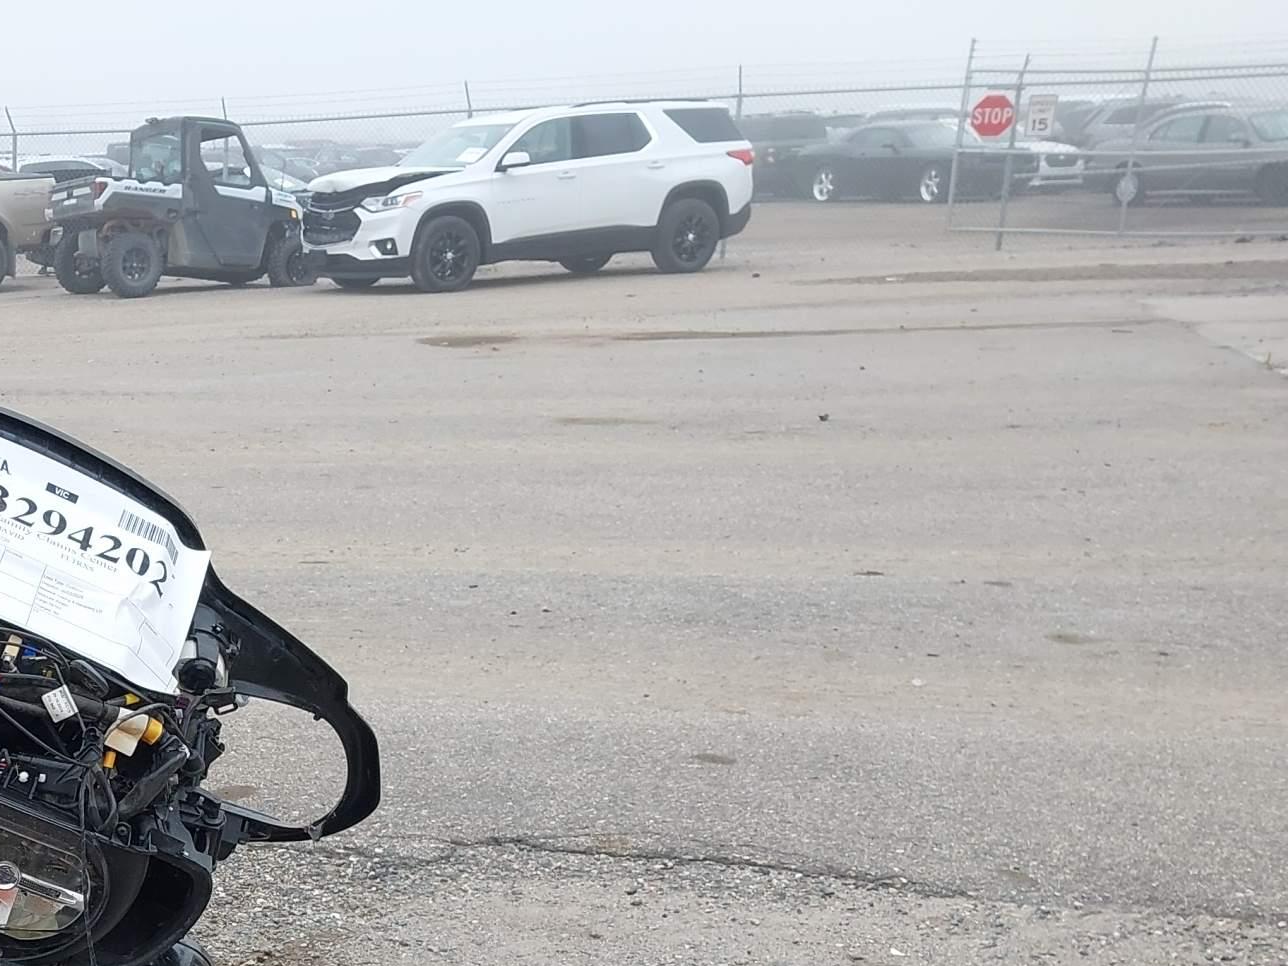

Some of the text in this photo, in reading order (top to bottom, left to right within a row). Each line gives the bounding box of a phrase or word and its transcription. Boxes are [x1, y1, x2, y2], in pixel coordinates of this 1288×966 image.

[973, 107, 1013, 124] STOP
[1031, 117, 1049, 131] 15
[54, 487, 71, 500] VIC
[80, 551, 118, 574] Center
